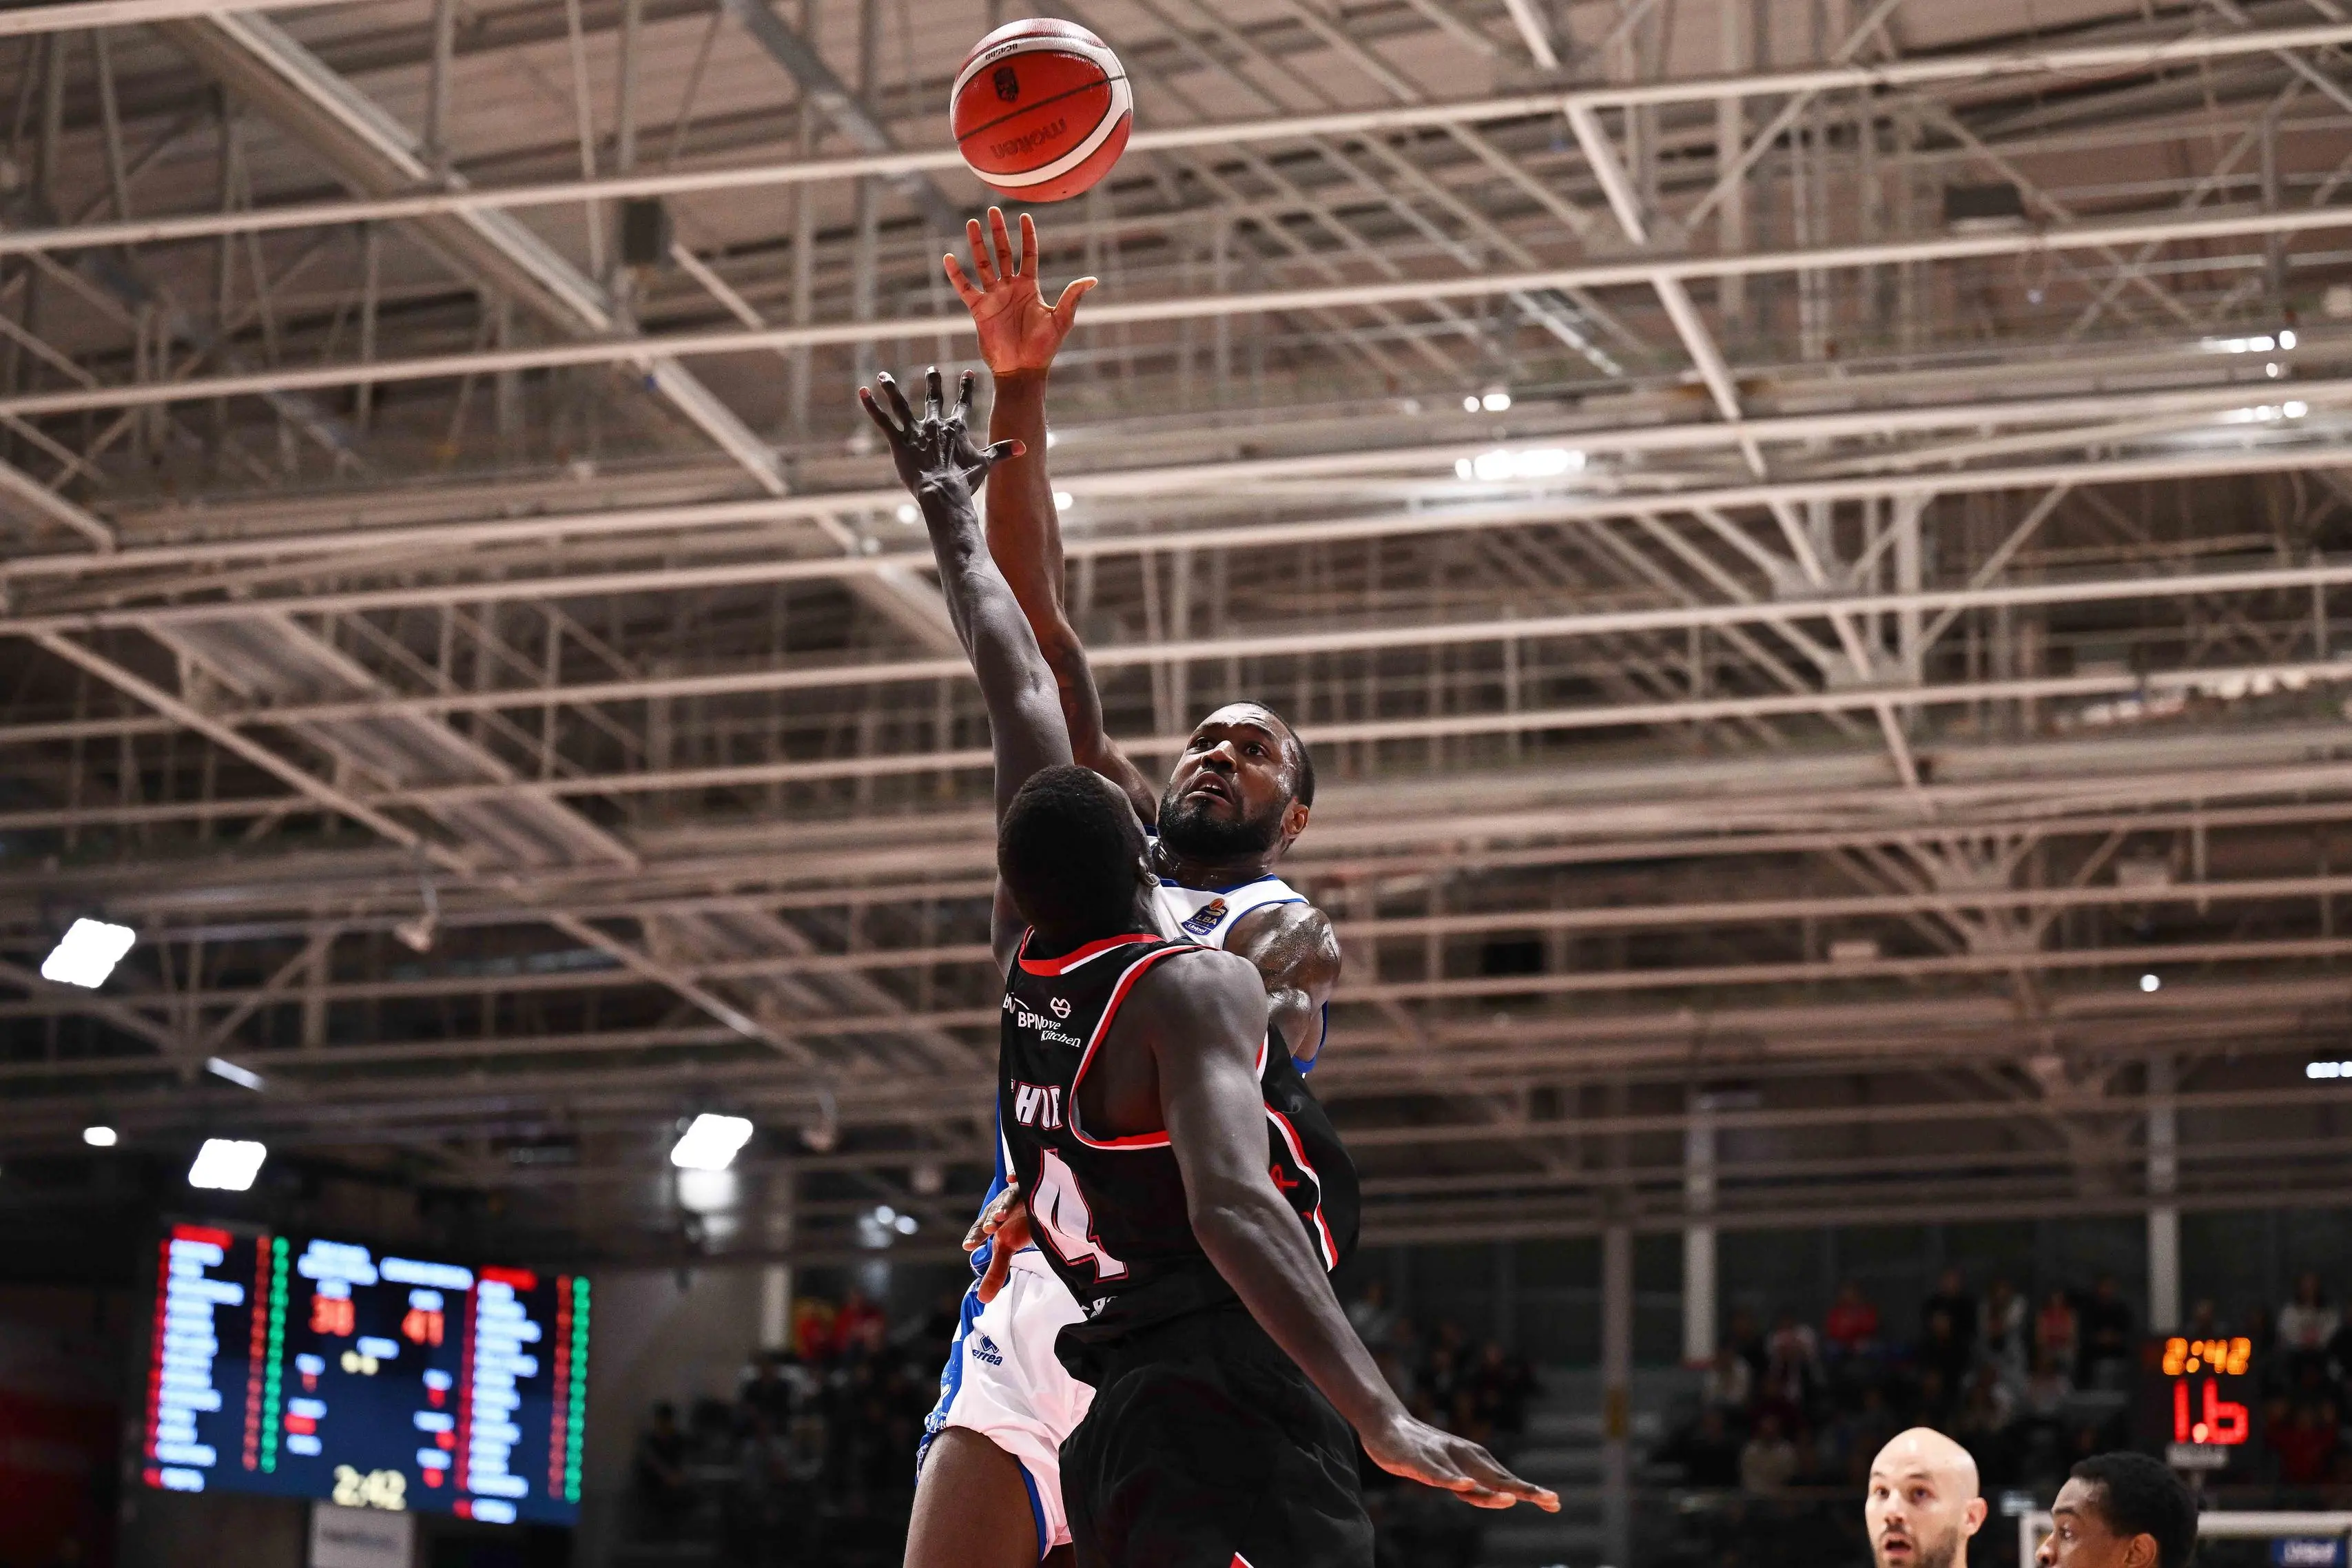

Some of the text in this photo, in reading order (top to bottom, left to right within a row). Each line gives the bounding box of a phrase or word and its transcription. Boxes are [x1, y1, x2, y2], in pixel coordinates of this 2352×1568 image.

[990, 118, 1067, 160] molten
[1195, 914, 1217, 925] LBA
[1188, 923, 1207, 933] Unipol
[1041, 1019, 1061, 1030] ove
[1041, 1030, 1081, 1047] Kitchen
[1029, 1146, 1128, 1283] 4
